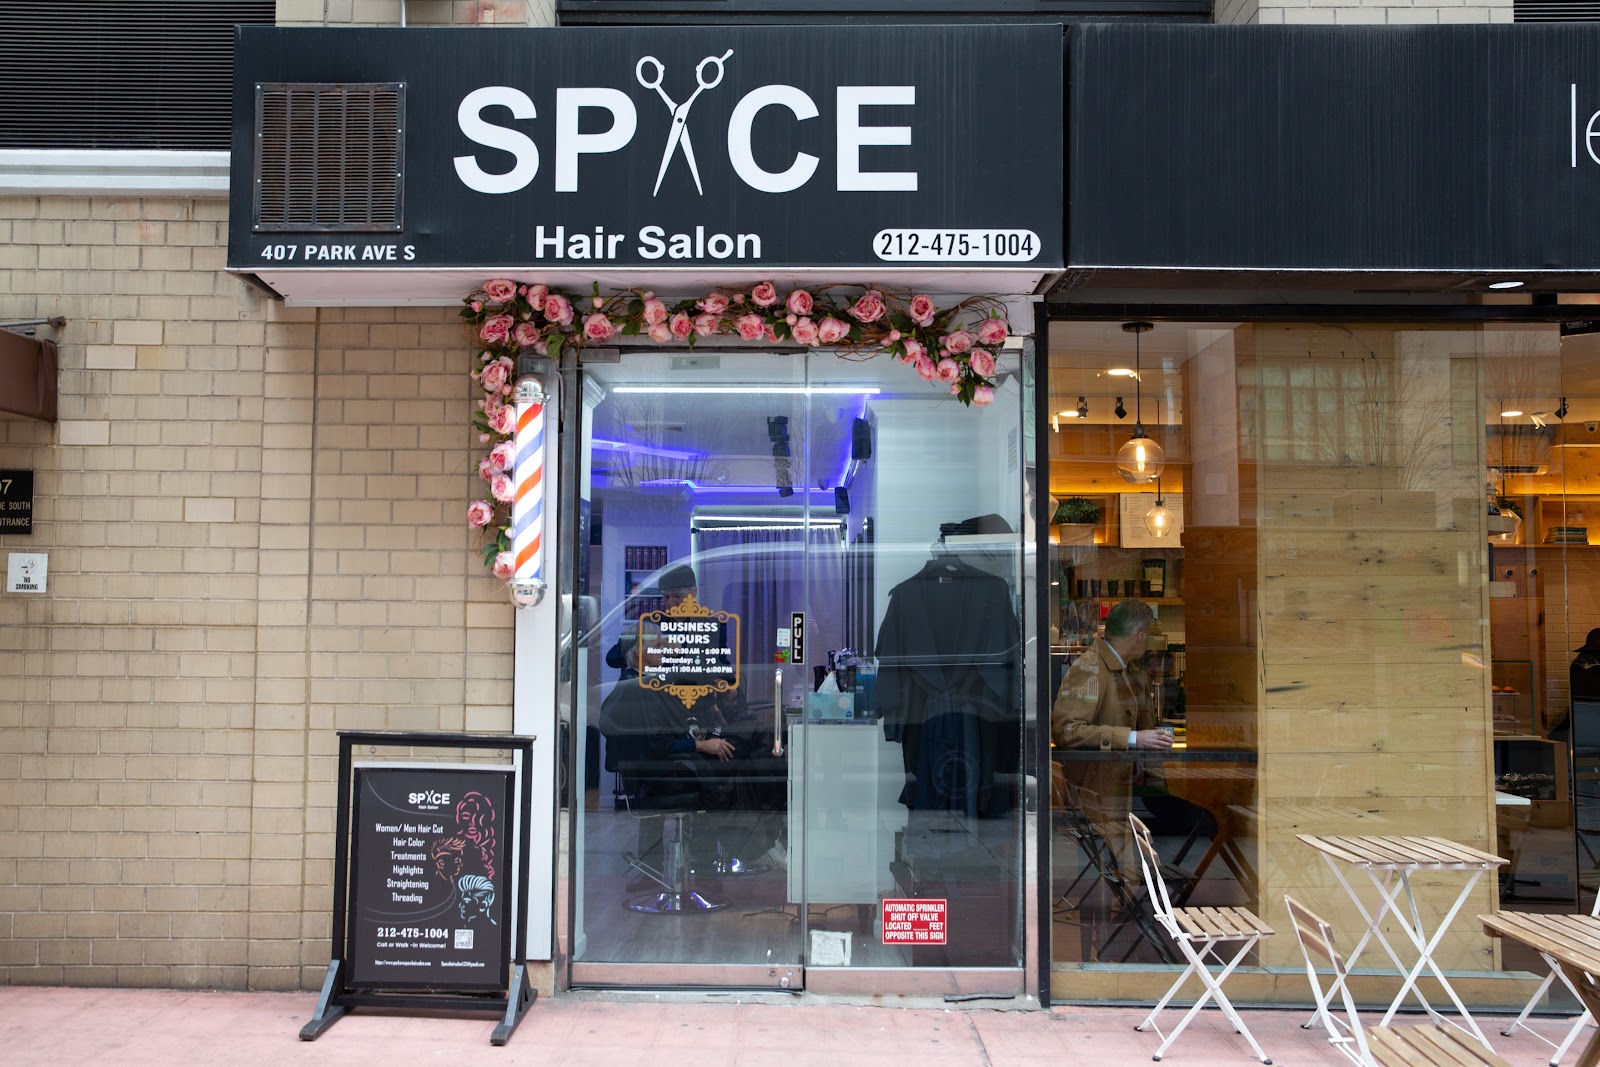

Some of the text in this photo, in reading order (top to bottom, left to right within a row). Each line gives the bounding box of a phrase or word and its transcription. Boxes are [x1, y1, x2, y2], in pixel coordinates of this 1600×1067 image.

[1571, 83, 1600, 168] l
[535, 225, 762, 260] Hair Salon
[881, 232, 1034, 256] 212-475-1004
[261, 244, 416, 261] 407 PARK AVE S
[0, 479, 12, 494] 7
[8, 501, 31, 511] SOUTH
[16, 583, 38, 591] SMOKING
[660, 621, 718, 632] BUSINESS
[668, 634, 710, 644] HOURS
[794, 616, 803, 660] PULL
[720, 647, 731, 655] PM
[661, 656, 694, 665] Saturday:
[644, 666, 671, 674] Sunday:
[403, 823, 417, 833] Men
[417, 823, 431, 833] Hair
[432, 824, 444, 834] Cut
[393, 837, 425, 847] Hair Color
[391, 850, 427, 861] Treatments
[392, 864, 424, 876] Highlights
[386, 878, 429, 890] Straightening
[392, 892, 423, 904] Threading
[885, 903, 945, 912] AUTOMATIC SPRINKLER
[891, 913, 939, 921] SHUT OFF VALVE
[885, 922, 943, 931] LOCATED FEET
[377, 927, 449, 938] 212-475-1004
[885, 931, 944, 940] OPPOSITE THIS SIGN
